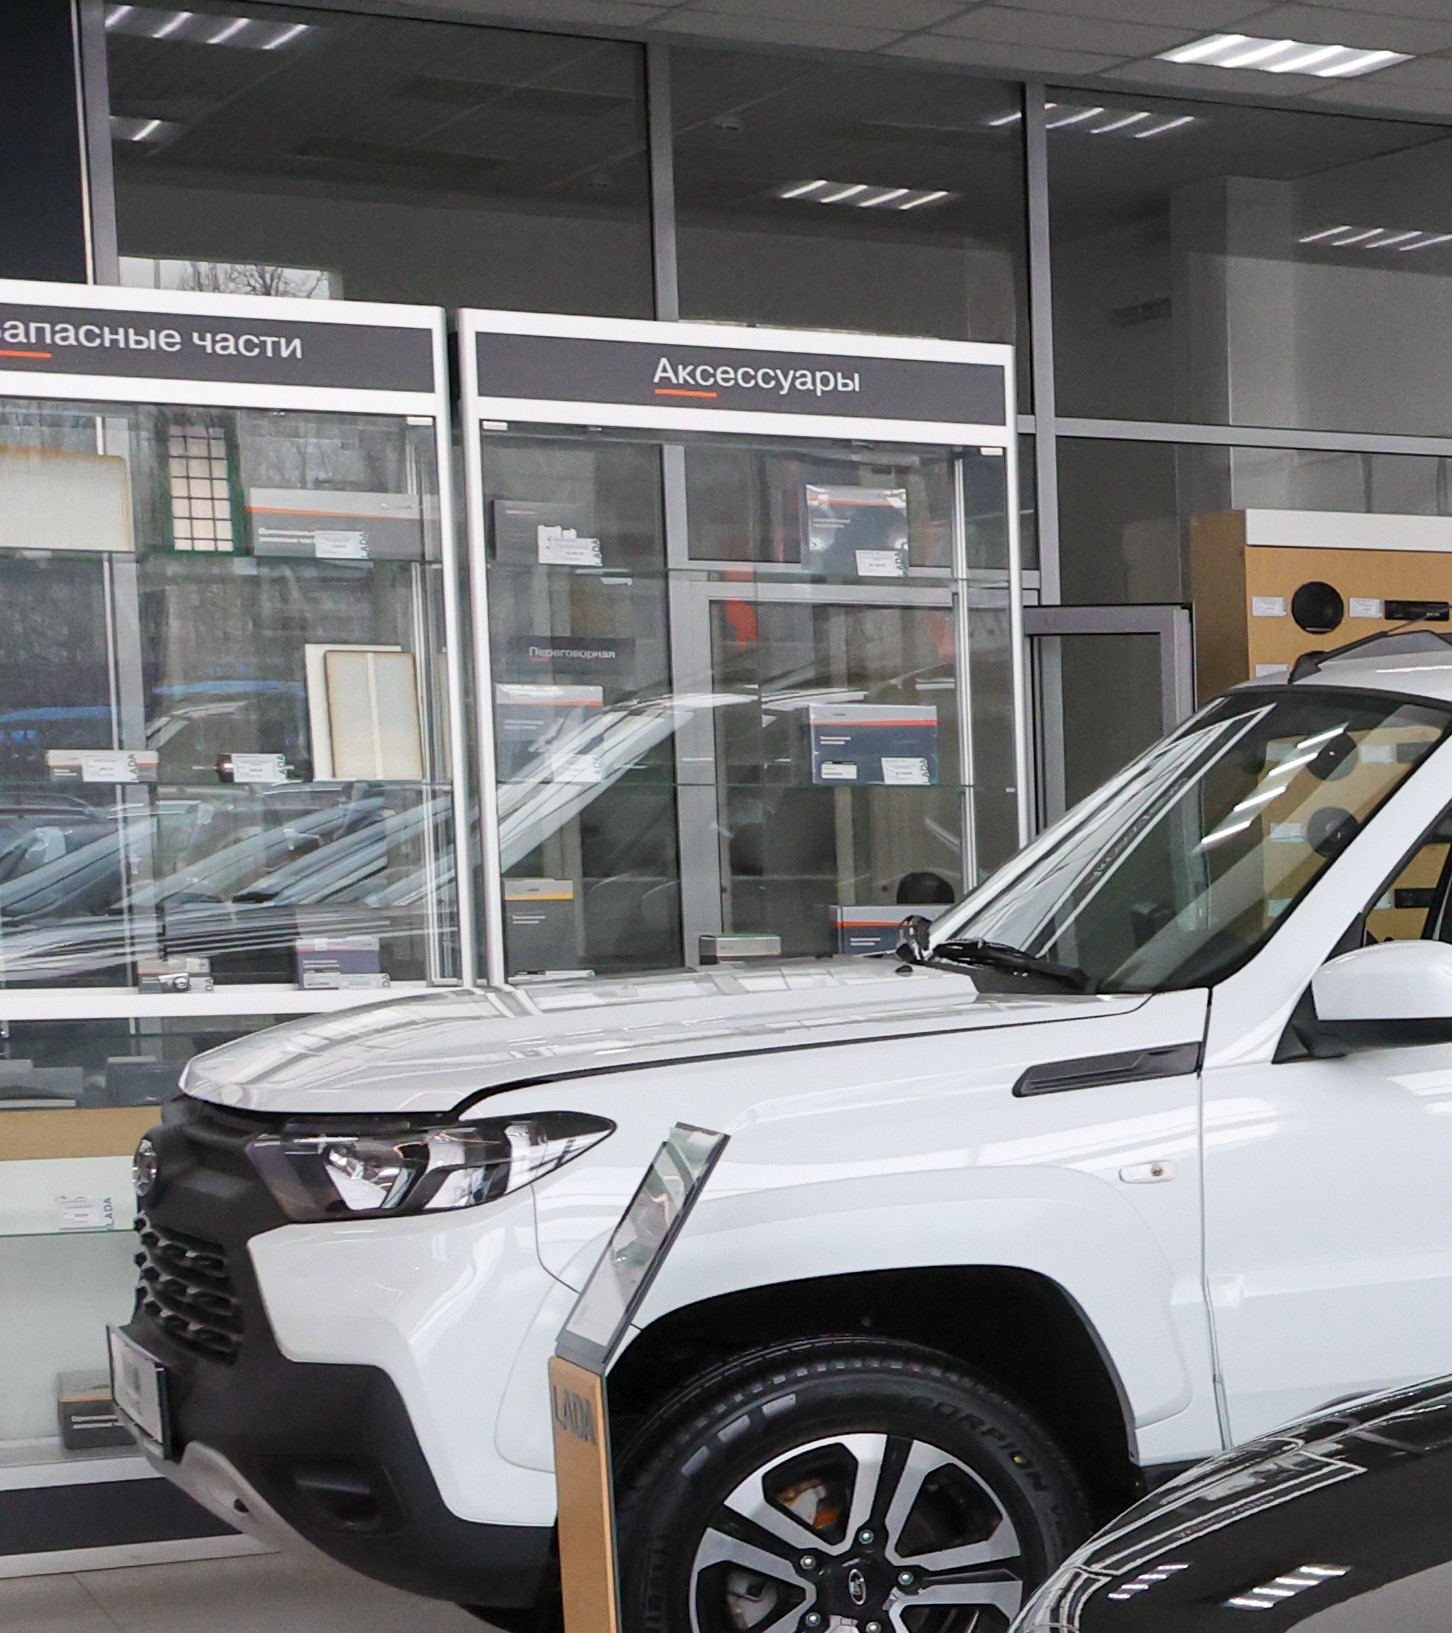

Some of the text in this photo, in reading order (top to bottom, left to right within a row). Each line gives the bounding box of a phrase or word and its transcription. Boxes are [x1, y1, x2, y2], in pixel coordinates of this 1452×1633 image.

[0, 319, 303, 360] апасные части
[653, 356, 861, 397] Аксессуары
[529, 646, 616, 659] Переговорная
[105, 1196, 113, 1228] LADA
[553, 1385, 597, 1445] LADA
